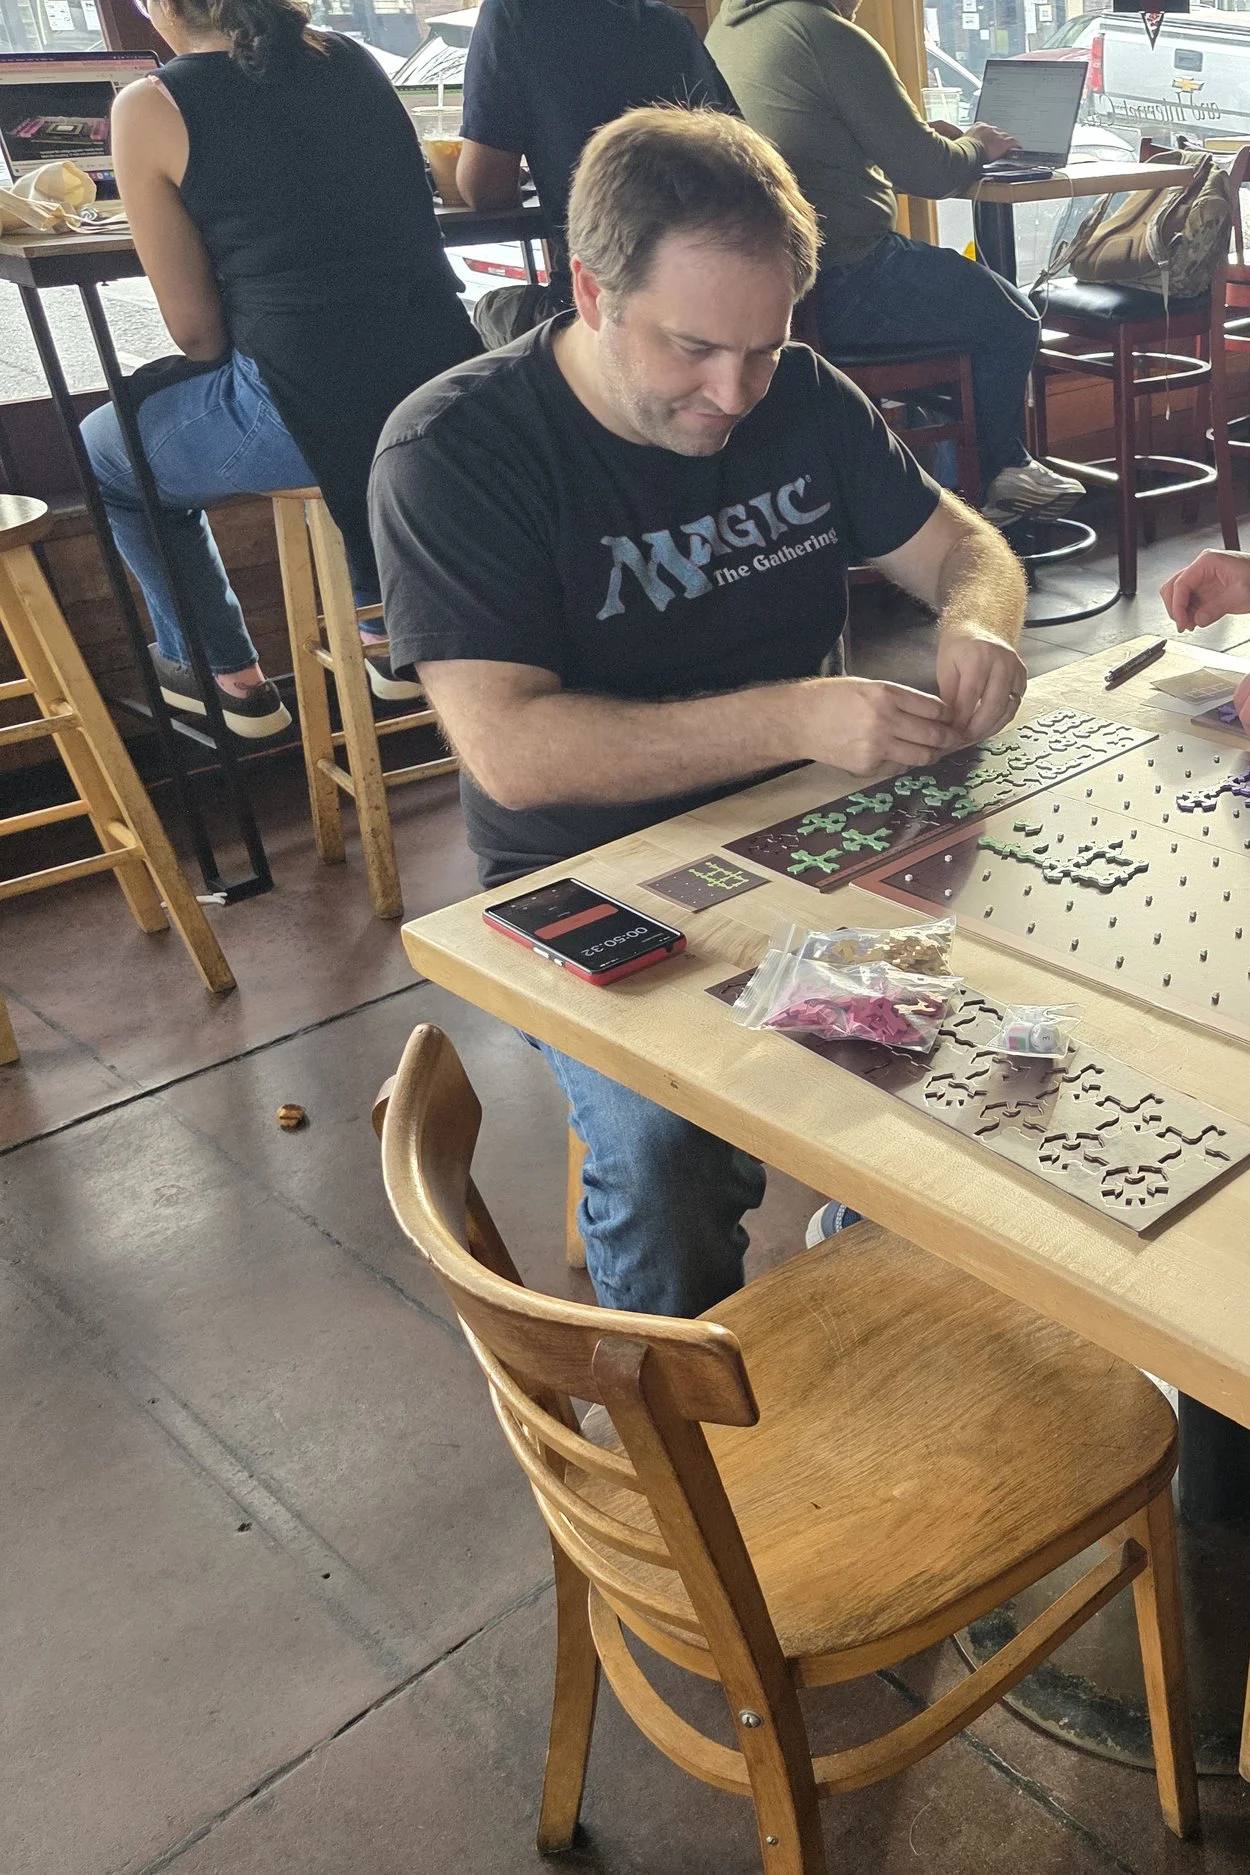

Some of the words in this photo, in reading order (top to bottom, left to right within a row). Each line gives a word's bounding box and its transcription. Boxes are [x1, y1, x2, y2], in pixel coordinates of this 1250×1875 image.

[596, 477, 832, 620] MAGIC
[712, 565, 751, 588] The
[752, 527, 838, 572] Gathering
[581, 927, 648, 956] 00:50.32
